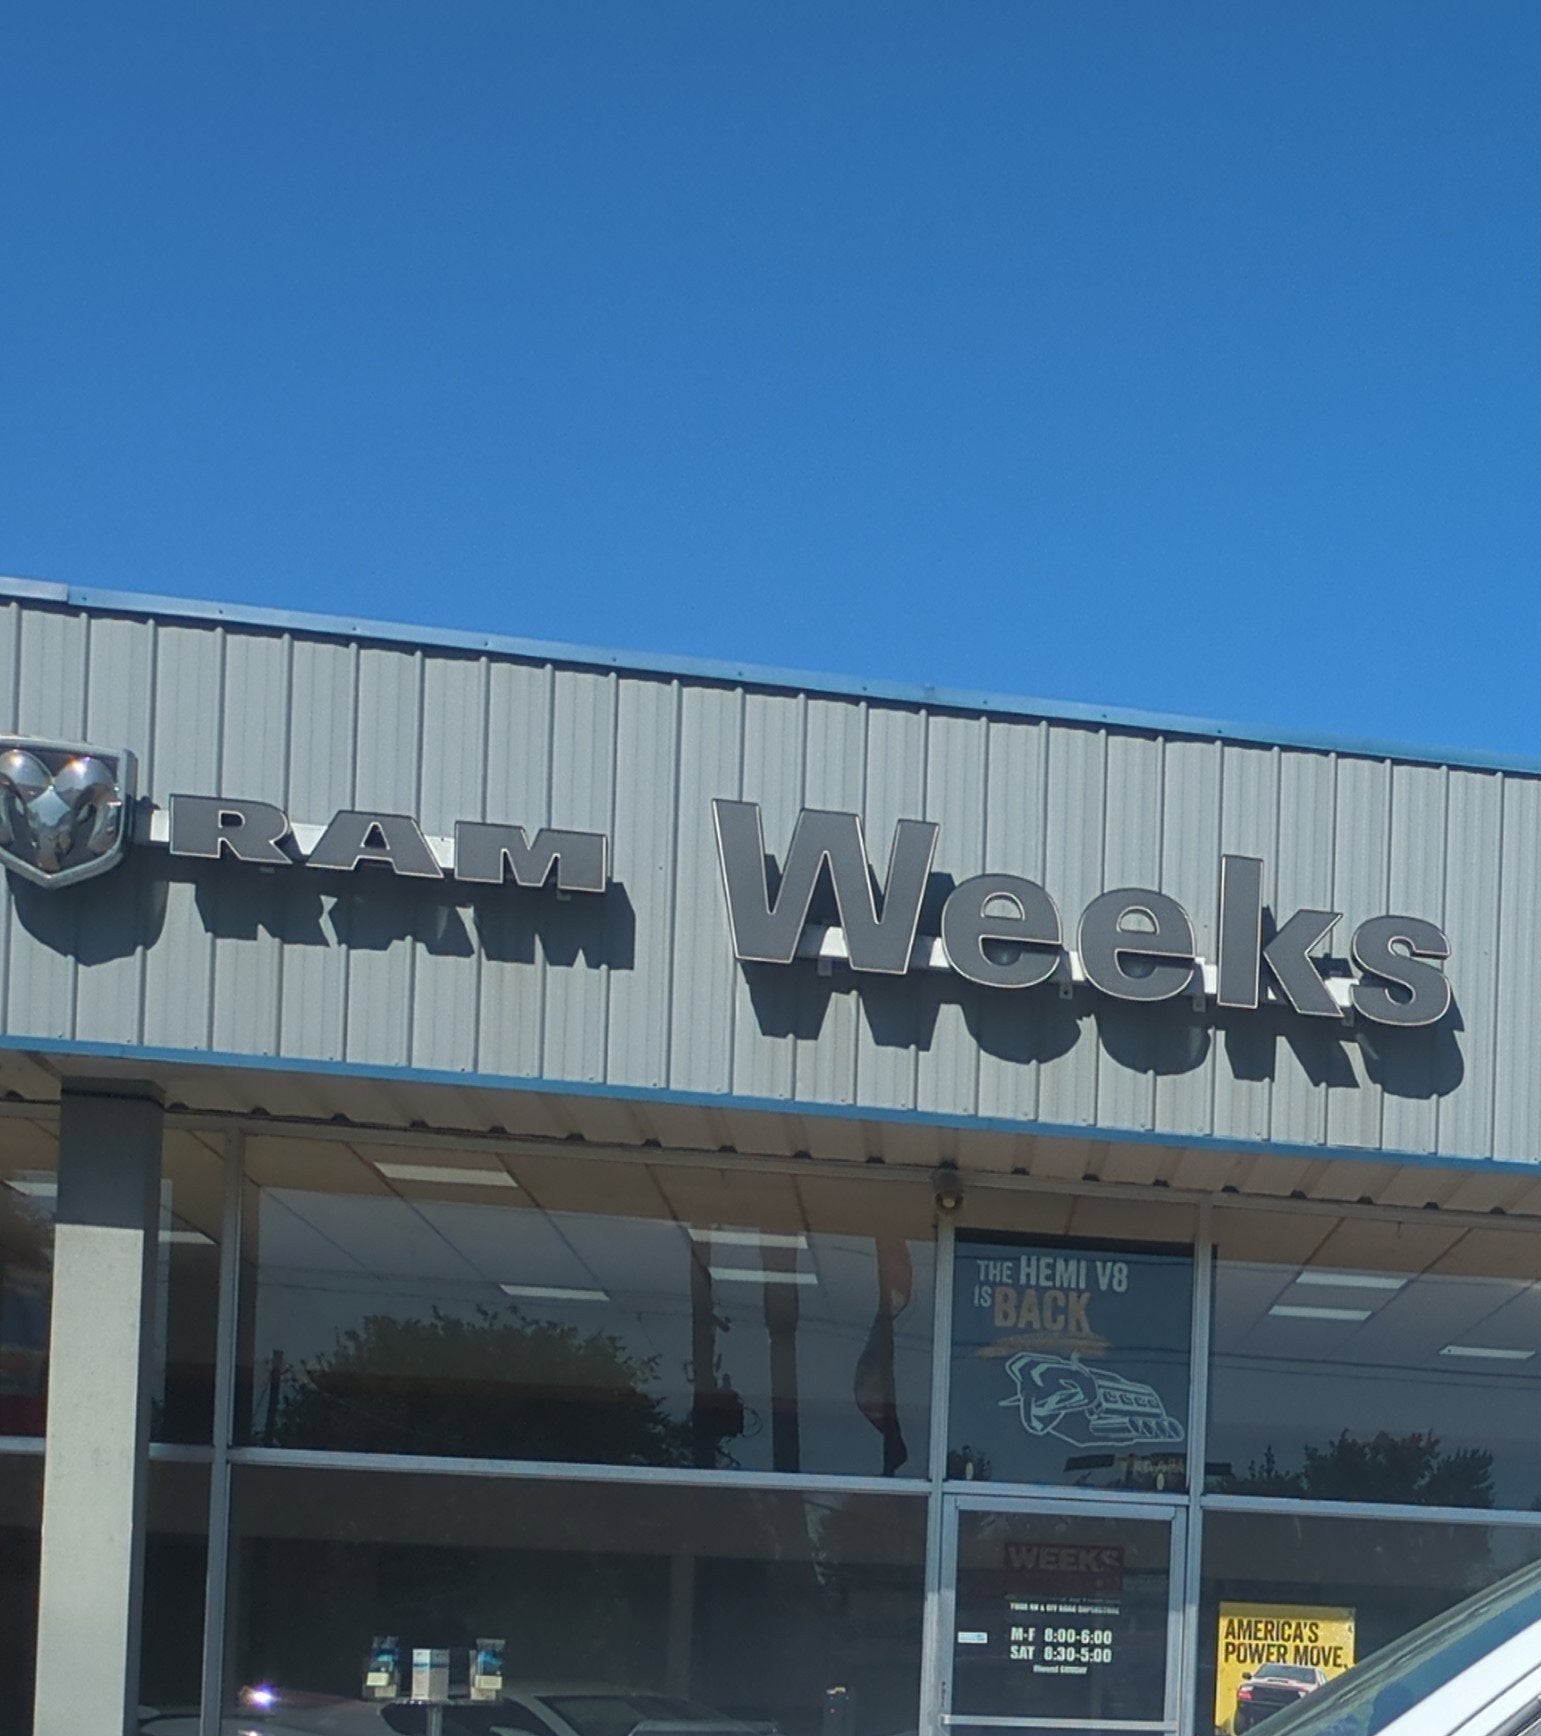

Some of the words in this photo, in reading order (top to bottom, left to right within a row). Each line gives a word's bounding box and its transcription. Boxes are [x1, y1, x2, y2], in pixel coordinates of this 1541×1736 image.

[168, 794, 608, 893] RAM
[712, 798, 1452, 1027] Weeks
[977, 1260, 1013, 1284] THE
[1019, 1255, 1088, 1290] HEMI
[1096, 1261, 1130, 1293] V8
[973, 1285, 993, 1308] IS
[994, 1287, 1092, 1336] BACK
[1008, 1546, 1122, 1573] WEEKS
[1011, 1627, 1036, 1642] M-F
[1044, 1628, 1113, 1645] 8:00-6:00
[1224, 1618, 1320, 1643] AMERICA'S
[1010, 1646, 1036, 1660] SAT
[1044, 1647, 1112, 1663] 8:30-5:00
[1224, 1642, 1289, 1664] POWER
